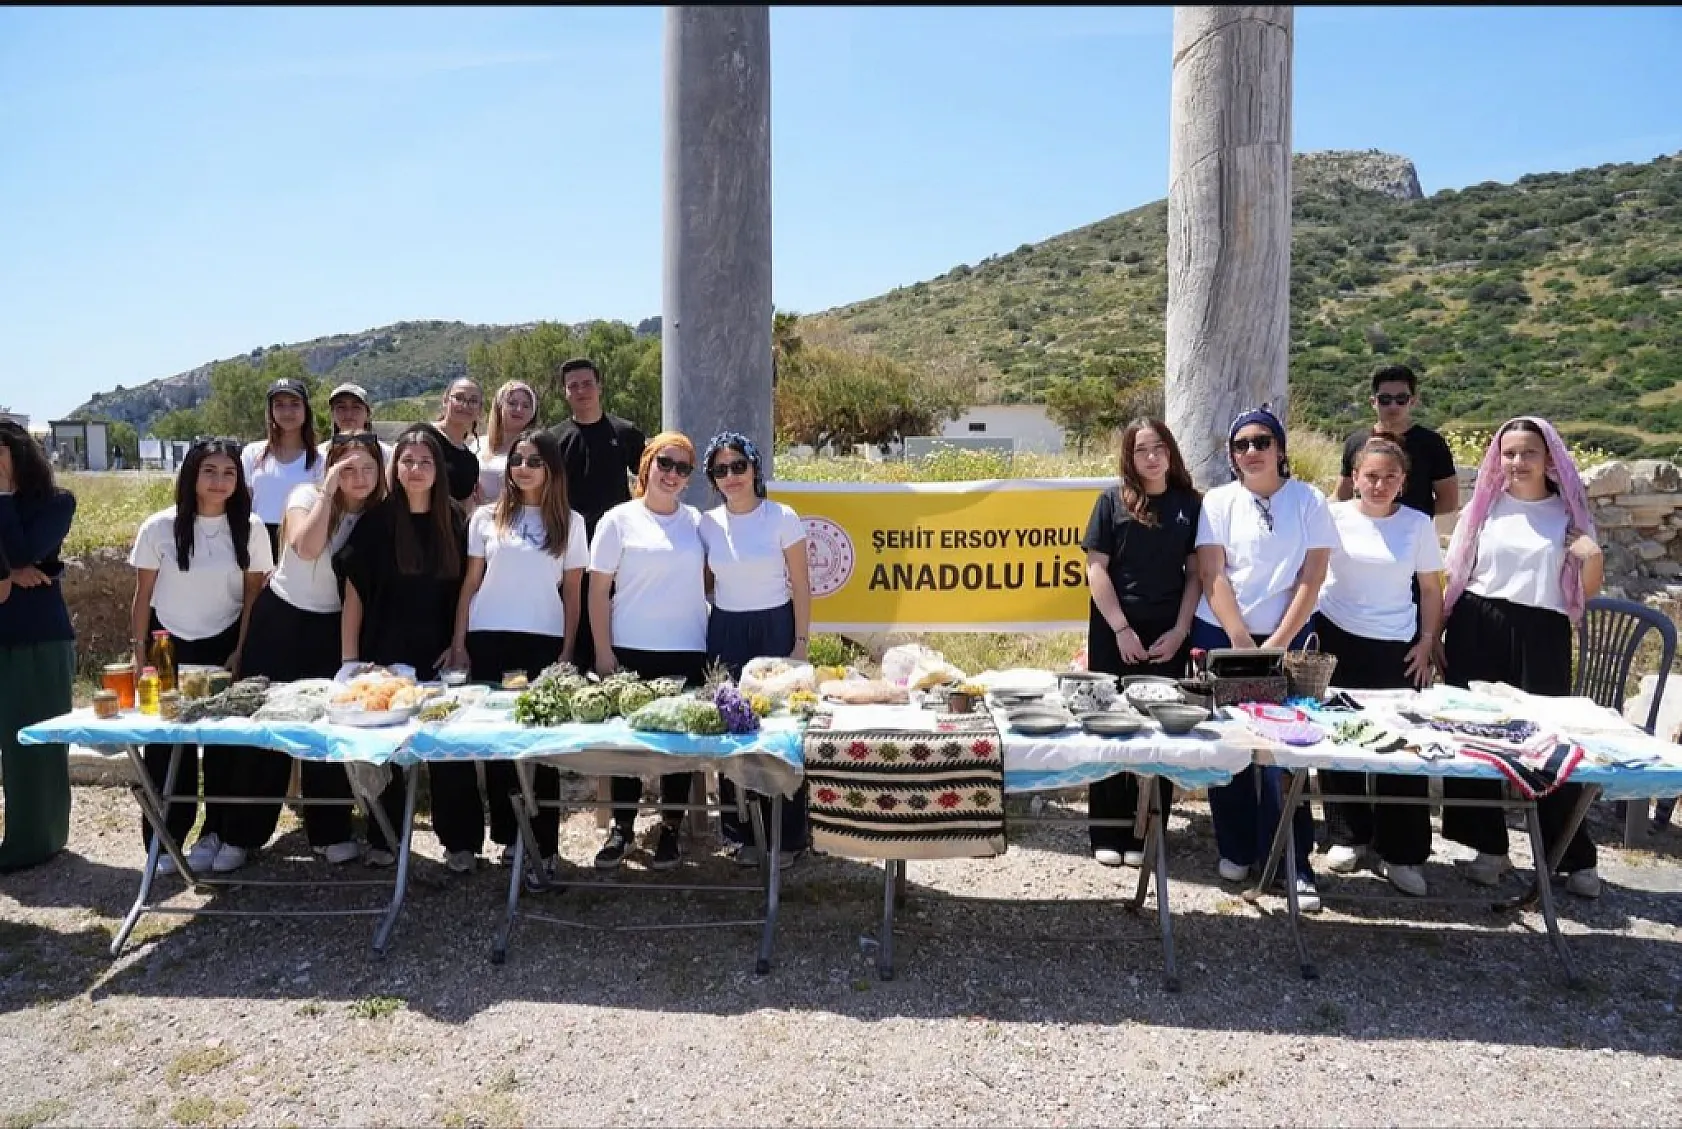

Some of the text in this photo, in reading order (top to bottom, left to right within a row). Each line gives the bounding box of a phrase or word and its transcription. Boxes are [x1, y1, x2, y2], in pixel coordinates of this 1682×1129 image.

[872, 525, 935, 553] ŞEHİT
[940, 529, 1011, 549] ERSOY
[868, 562, 1024, 591] ANADOLU
